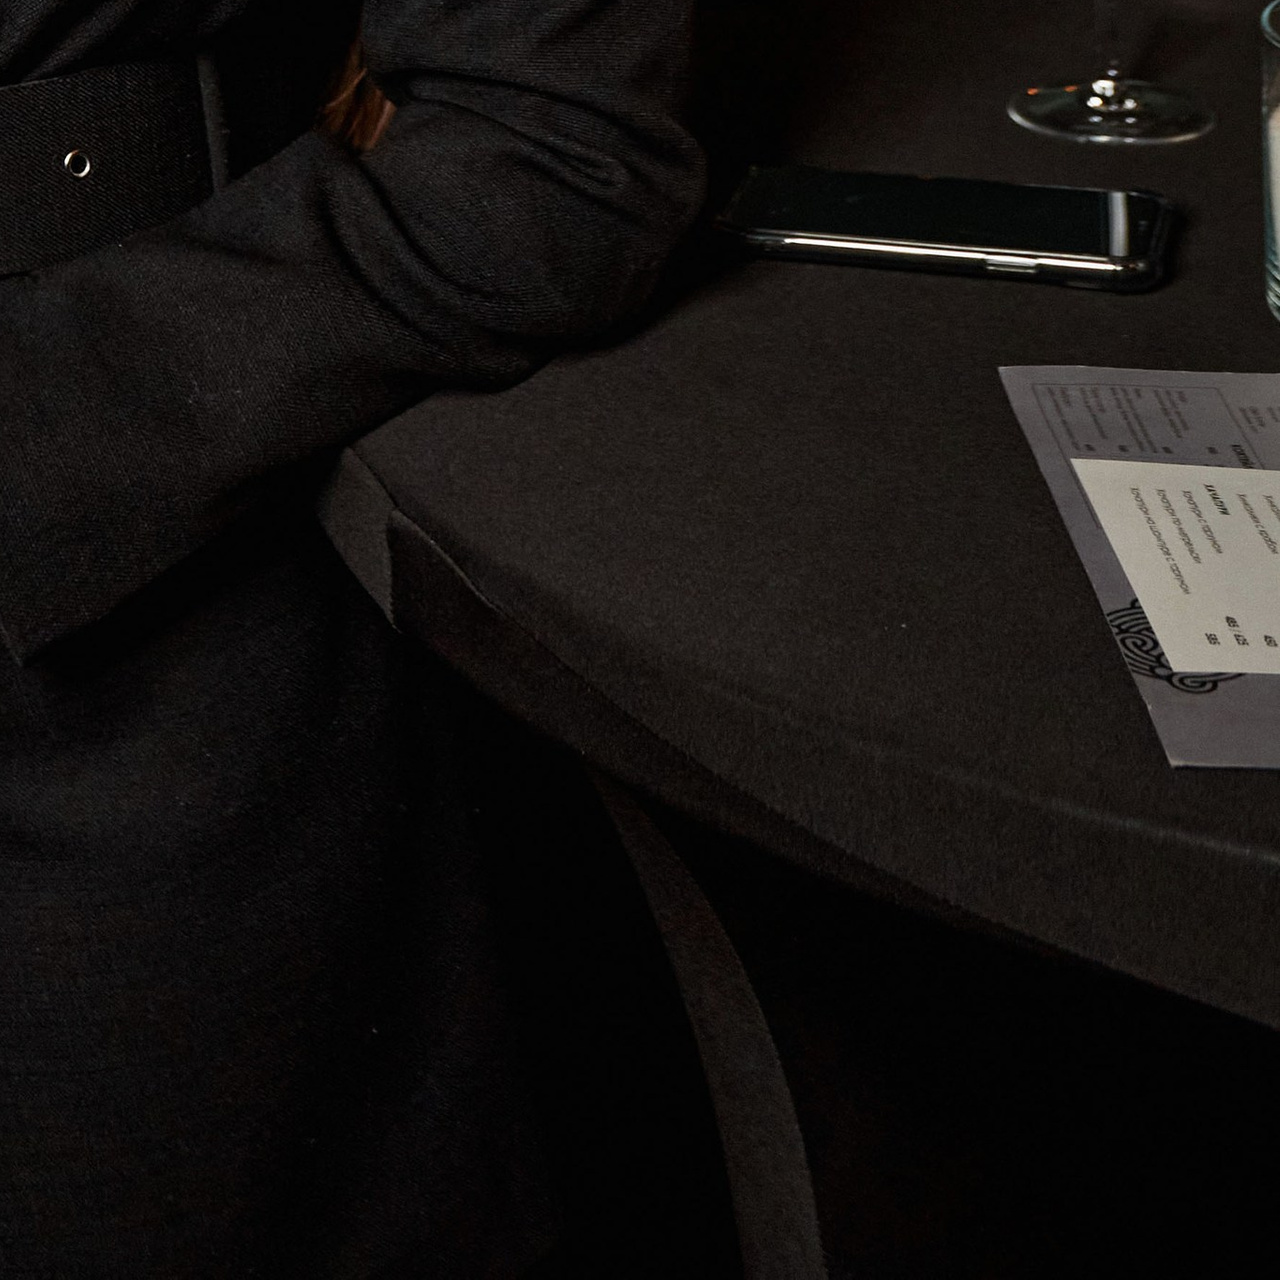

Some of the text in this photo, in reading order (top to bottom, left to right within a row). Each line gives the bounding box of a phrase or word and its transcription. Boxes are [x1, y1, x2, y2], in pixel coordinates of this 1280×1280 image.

[1129, 487, 1150, 516] Хачапури
[1155, 489, 1177, 517] Хачапури
[1181, 490, 1204, 519] Хачапури
[1203, 484, 1231, 516] ХАЧАПУРИ
